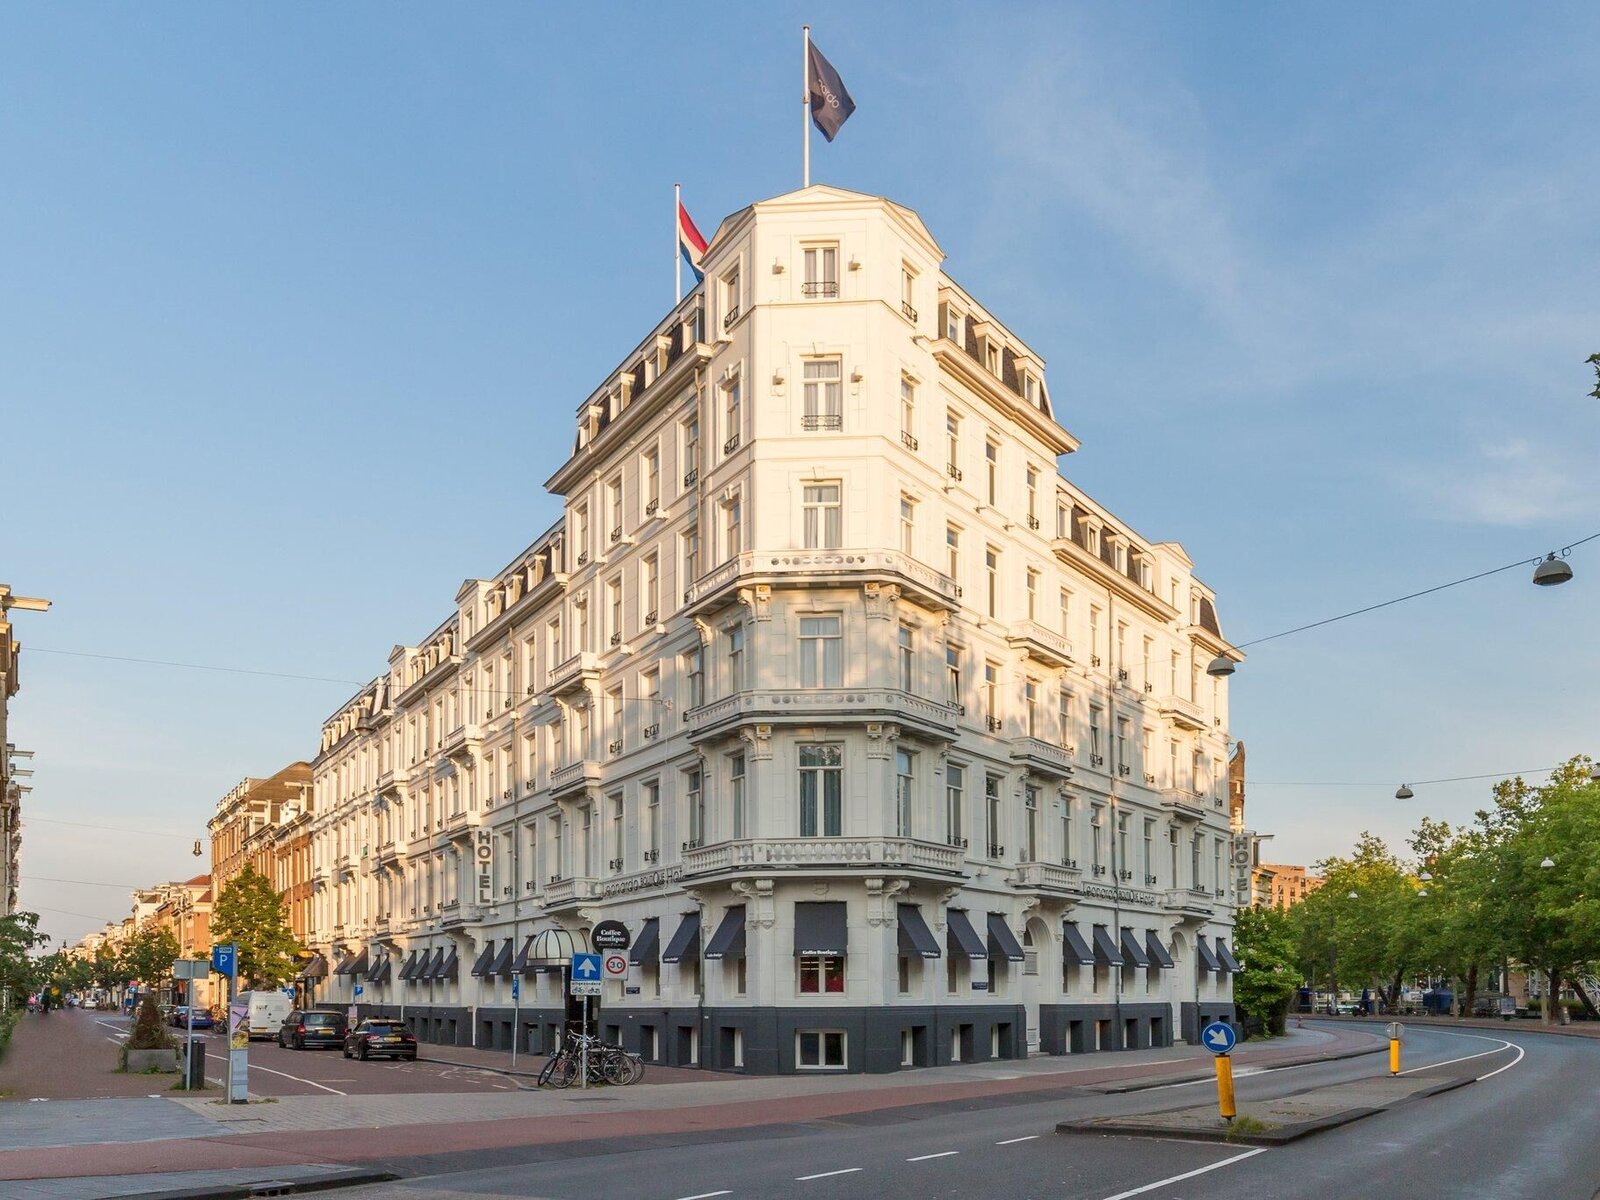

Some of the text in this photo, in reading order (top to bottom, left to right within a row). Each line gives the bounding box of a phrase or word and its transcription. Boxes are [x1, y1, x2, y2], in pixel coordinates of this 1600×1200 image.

[478, 831, 491, 903] HOTEL
[1235, 837, 1248, 905] HOTEL
[596, 935, 626, 944] Boutique
[219, 954, 228, 967] P
[609, 961, 623, 969] 30
